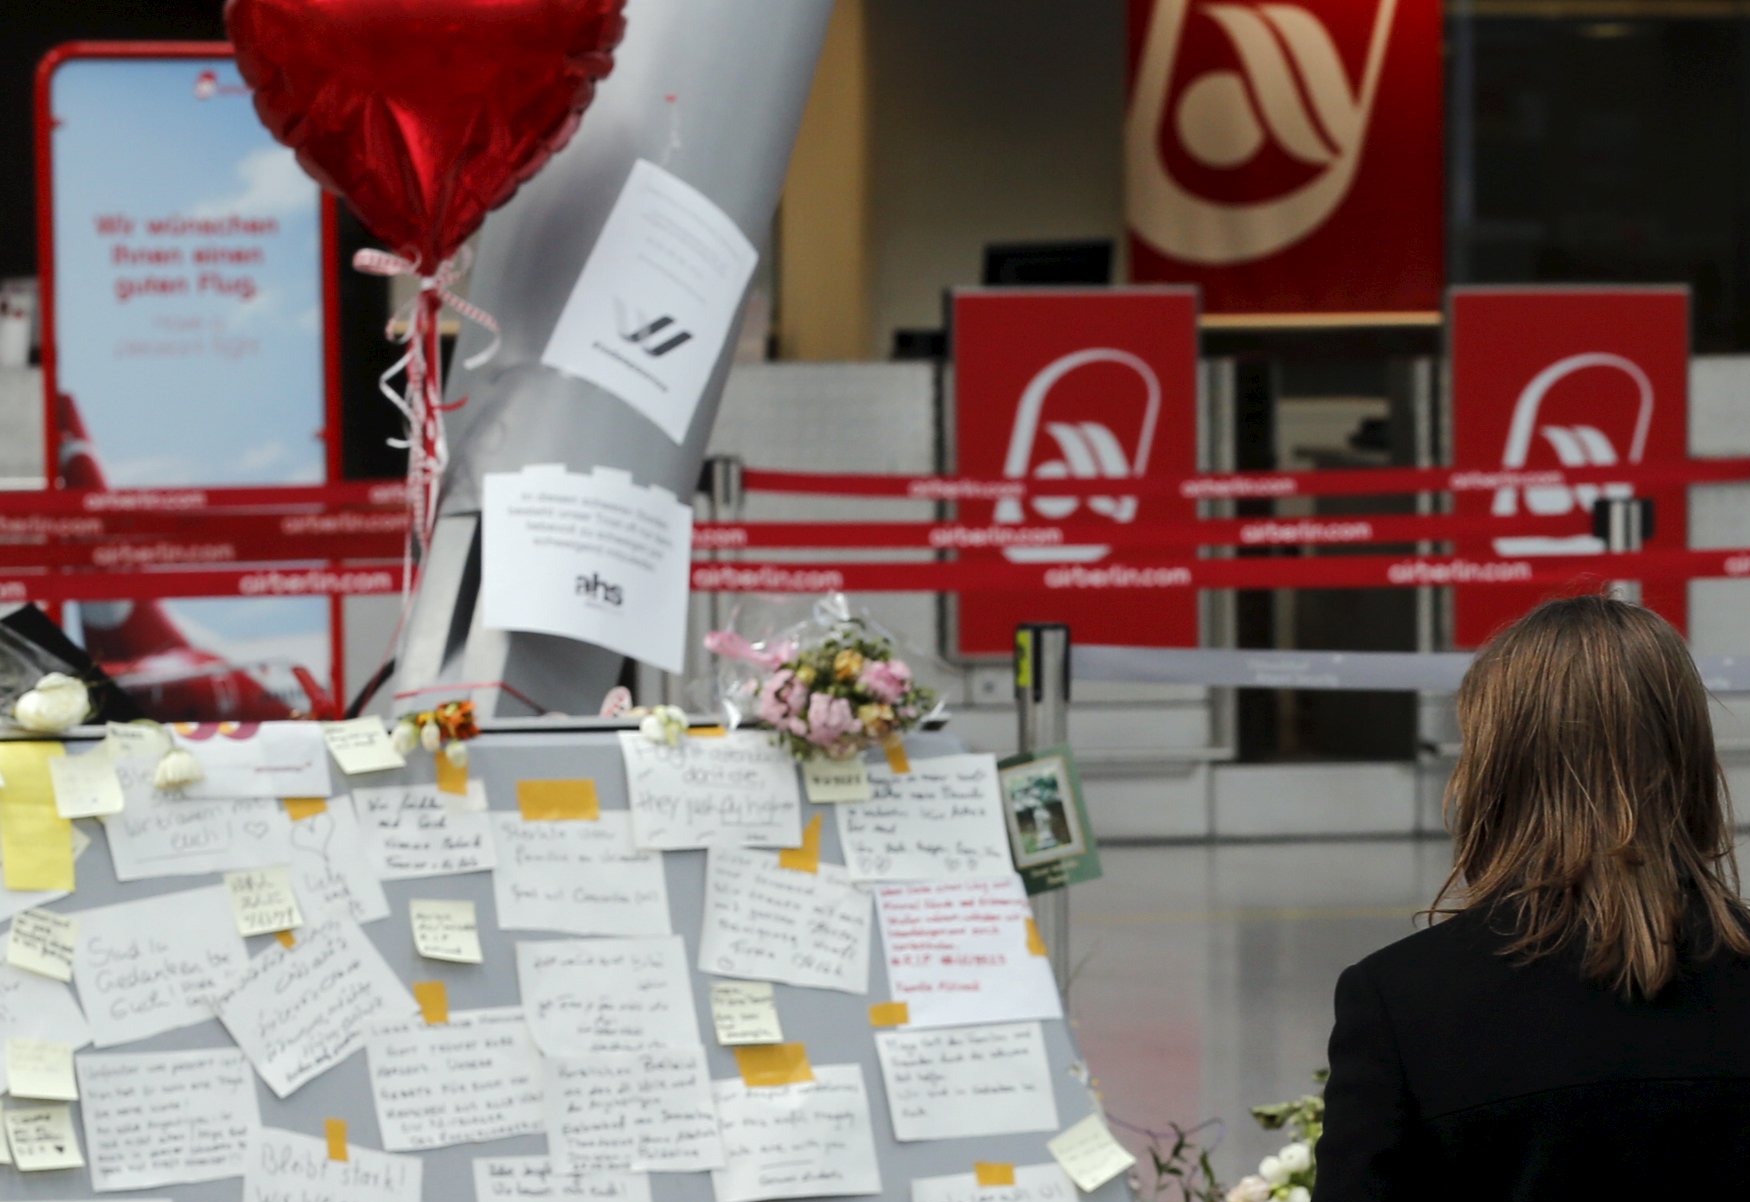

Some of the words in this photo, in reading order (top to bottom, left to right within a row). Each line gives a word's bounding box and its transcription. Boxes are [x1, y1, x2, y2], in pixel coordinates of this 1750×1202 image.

[239, 568, 393, 595] airberlin.com
[1044, 564, 1193, 589] airberlin.com
[1388, 560, 1533, 584] airberlin.com
